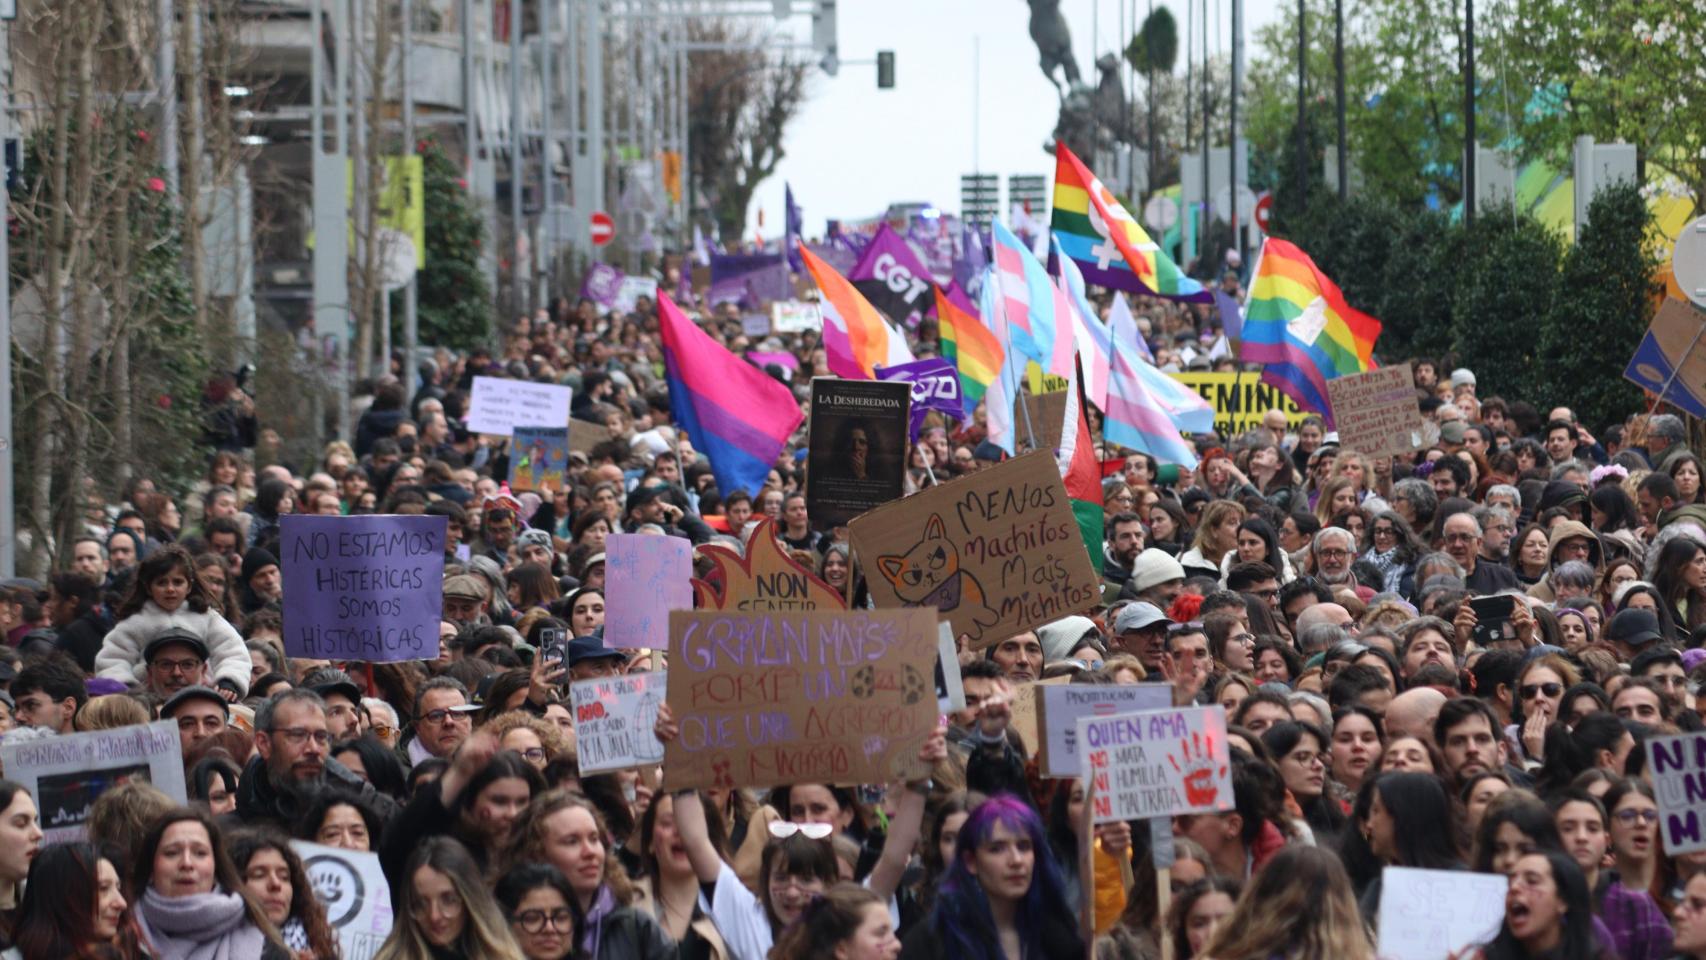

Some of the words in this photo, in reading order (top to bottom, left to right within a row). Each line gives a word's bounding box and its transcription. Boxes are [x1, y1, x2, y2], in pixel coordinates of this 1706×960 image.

[873, 253, 929, 304] CGT
[818, 394, 832, 404] LA
[833, 395, 901, 408] DESHEREDADA
[956, 482, 1056, 535] MENOS
[293, 531, 330, 562] NO
[337, 530, 437, 558] ESTAMOS
[756, 571, 808, 599] NON
[337, 594, 401, 620] SOMOS
[803, 667, 849, 702] UN
[679, 712, 737, 753] QUE
[1086, 719, 1143, 748] QUIEN
[1148, 712, 1189, 741] AMA
[1115, 746, 1146, 765] MATA
[1116, 764, 1168, 788] HUMILLA
[1094, 794, 1112, 817] NI
[1117, 788, 1183, 815] MALTRATA
